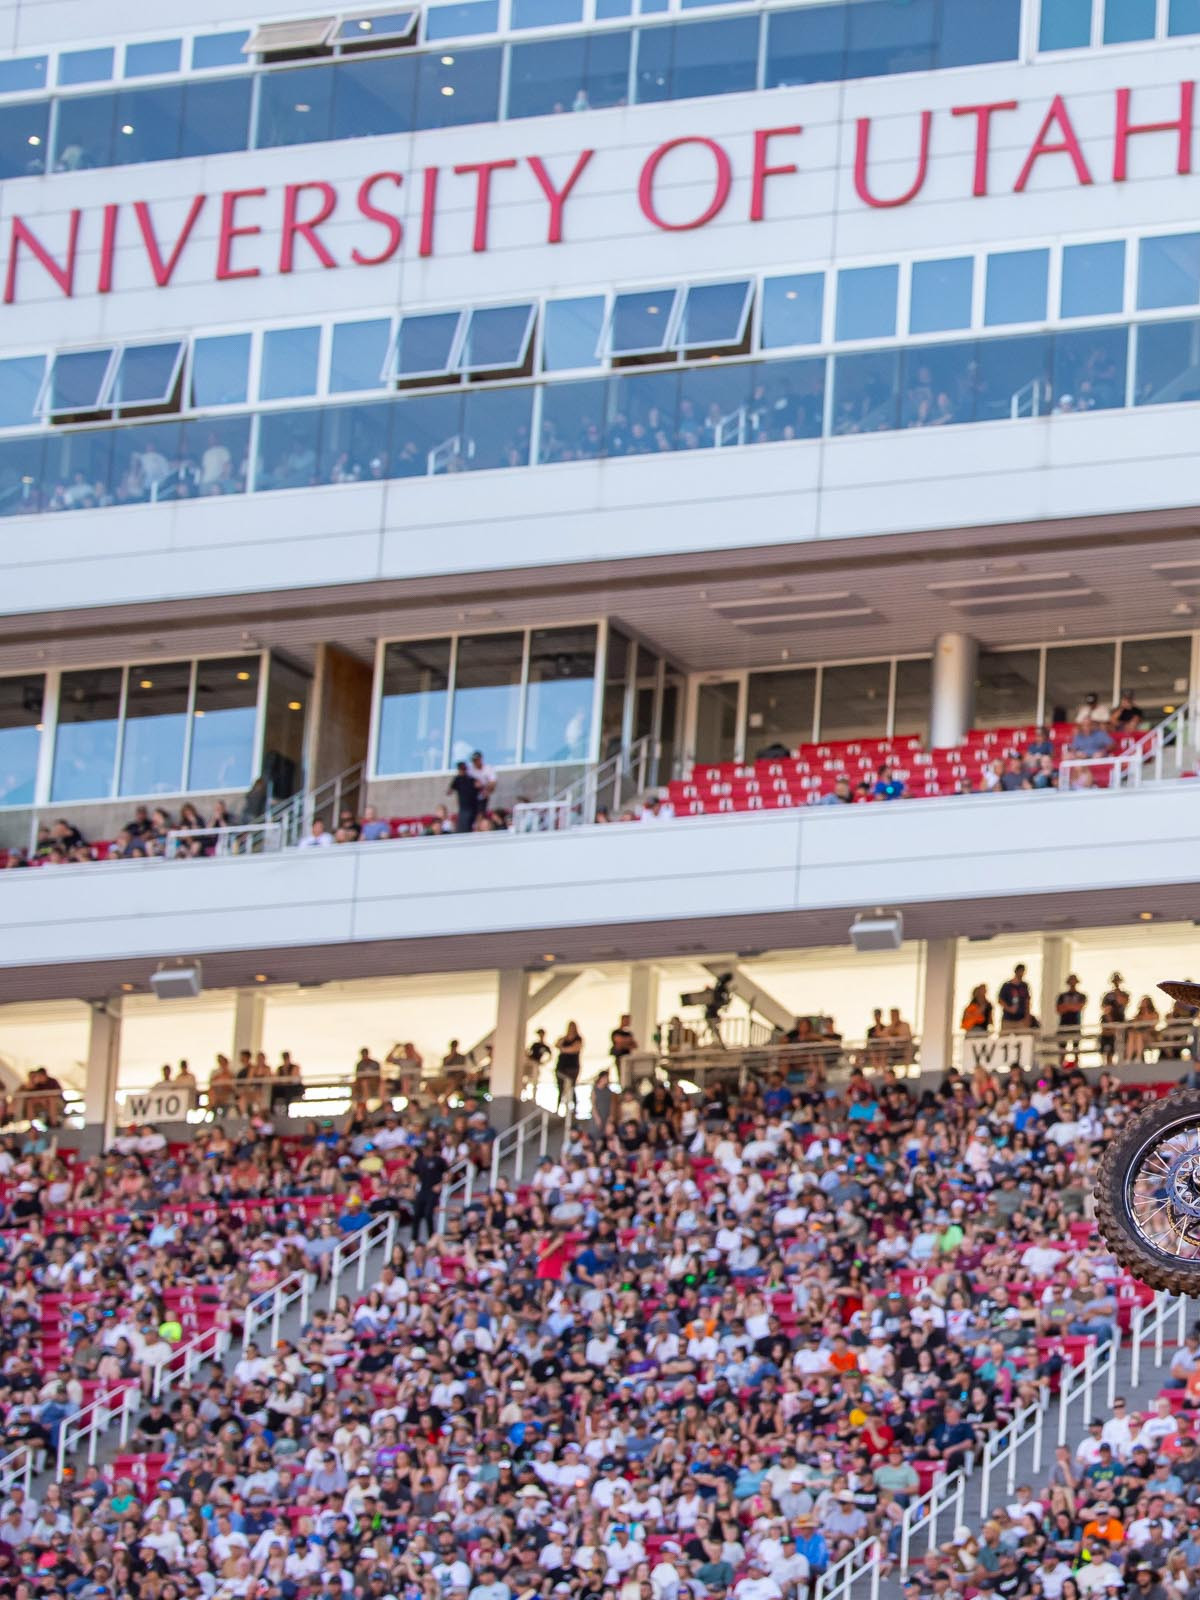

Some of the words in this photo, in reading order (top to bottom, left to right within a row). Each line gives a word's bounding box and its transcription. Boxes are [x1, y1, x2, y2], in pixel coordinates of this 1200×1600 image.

[638, 125, 802, 232] OF
[853, 80, 1196, 208] UTAH
[971, 1043, 1022, 1064] W11
[130, 1095, 180, 1116] W10
